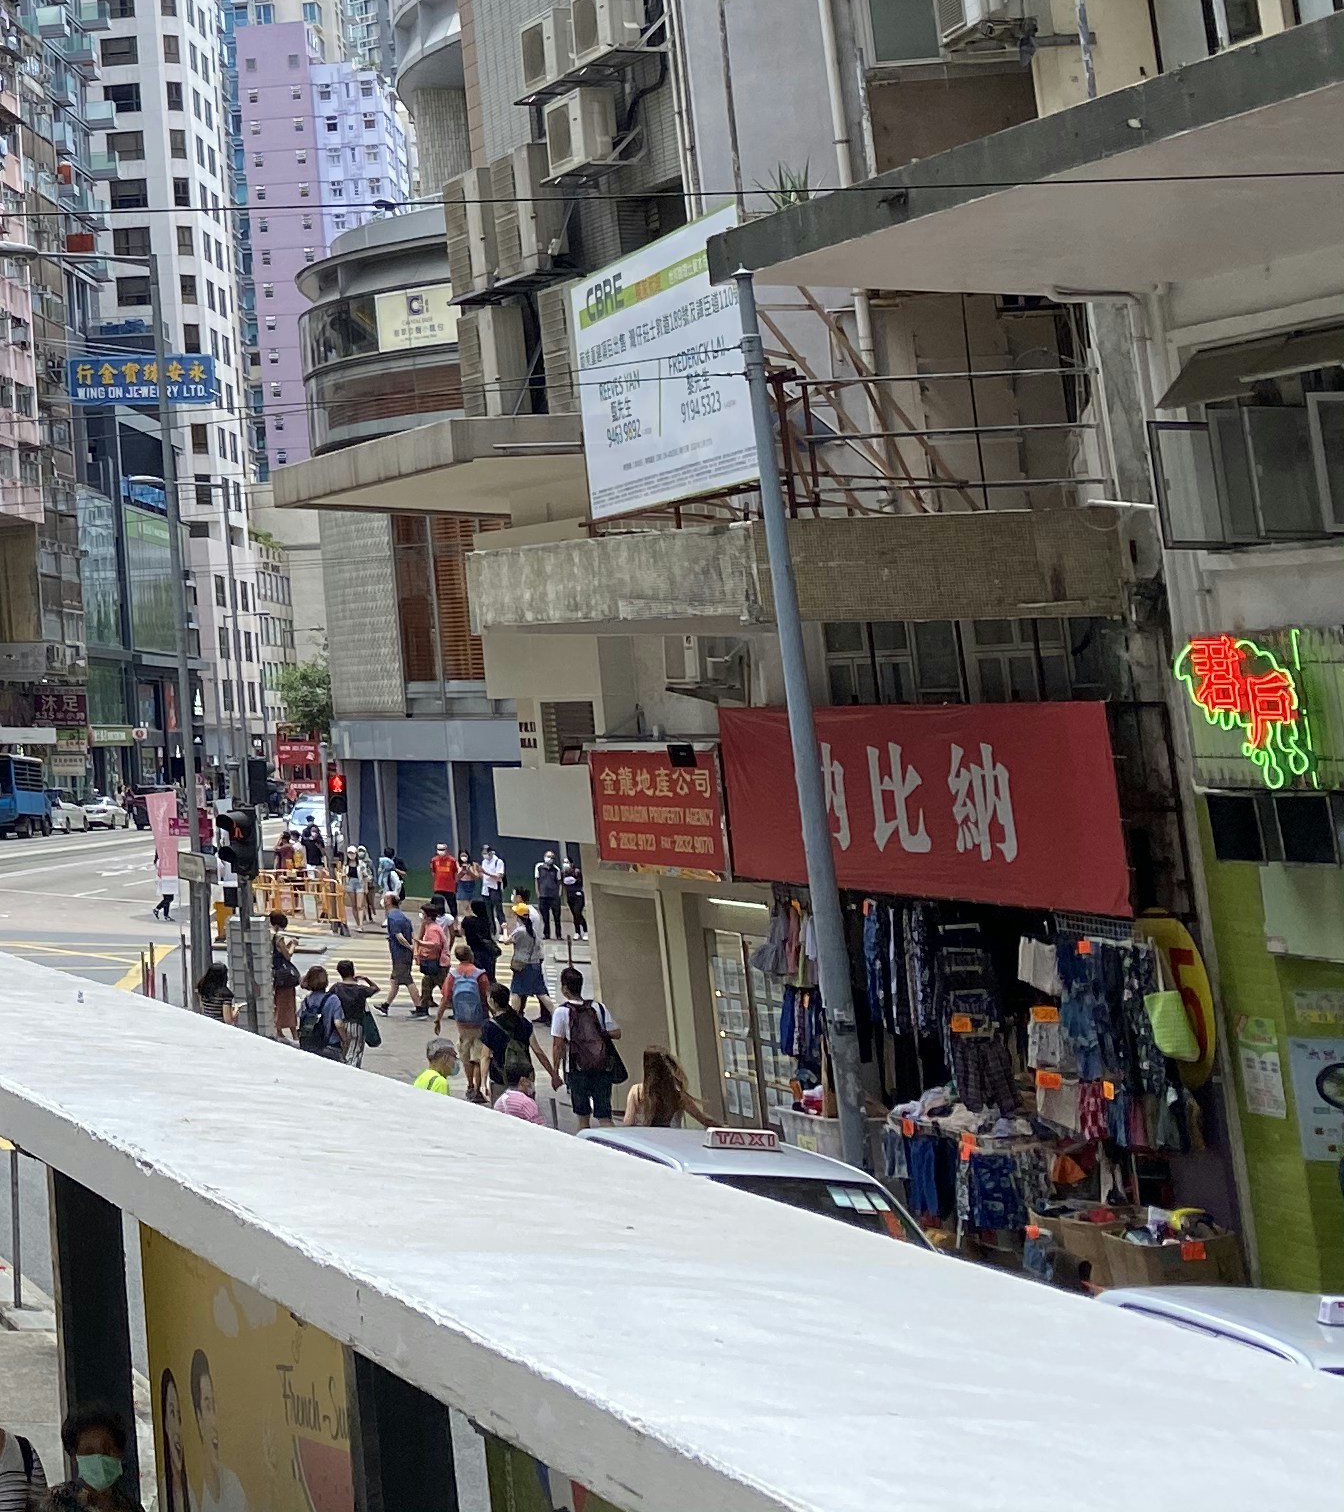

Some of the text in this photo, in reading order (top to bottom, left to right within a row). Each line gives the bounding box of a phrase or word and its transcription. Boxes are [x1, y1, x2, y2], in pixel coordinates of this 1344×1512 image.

[586, 272, 625, 322] CBRE
[77, 386, 106, 399] WING
[108, 386, 123, 398] ON
[183, 384, 208, 397] LTD.
[600, 766, 712, 798] 金龍地產公司
[602, 804, 714, 827] GOLD DRAGON PROPERTY AGENCY
[716, 1130, 776, 1147] TAXI
